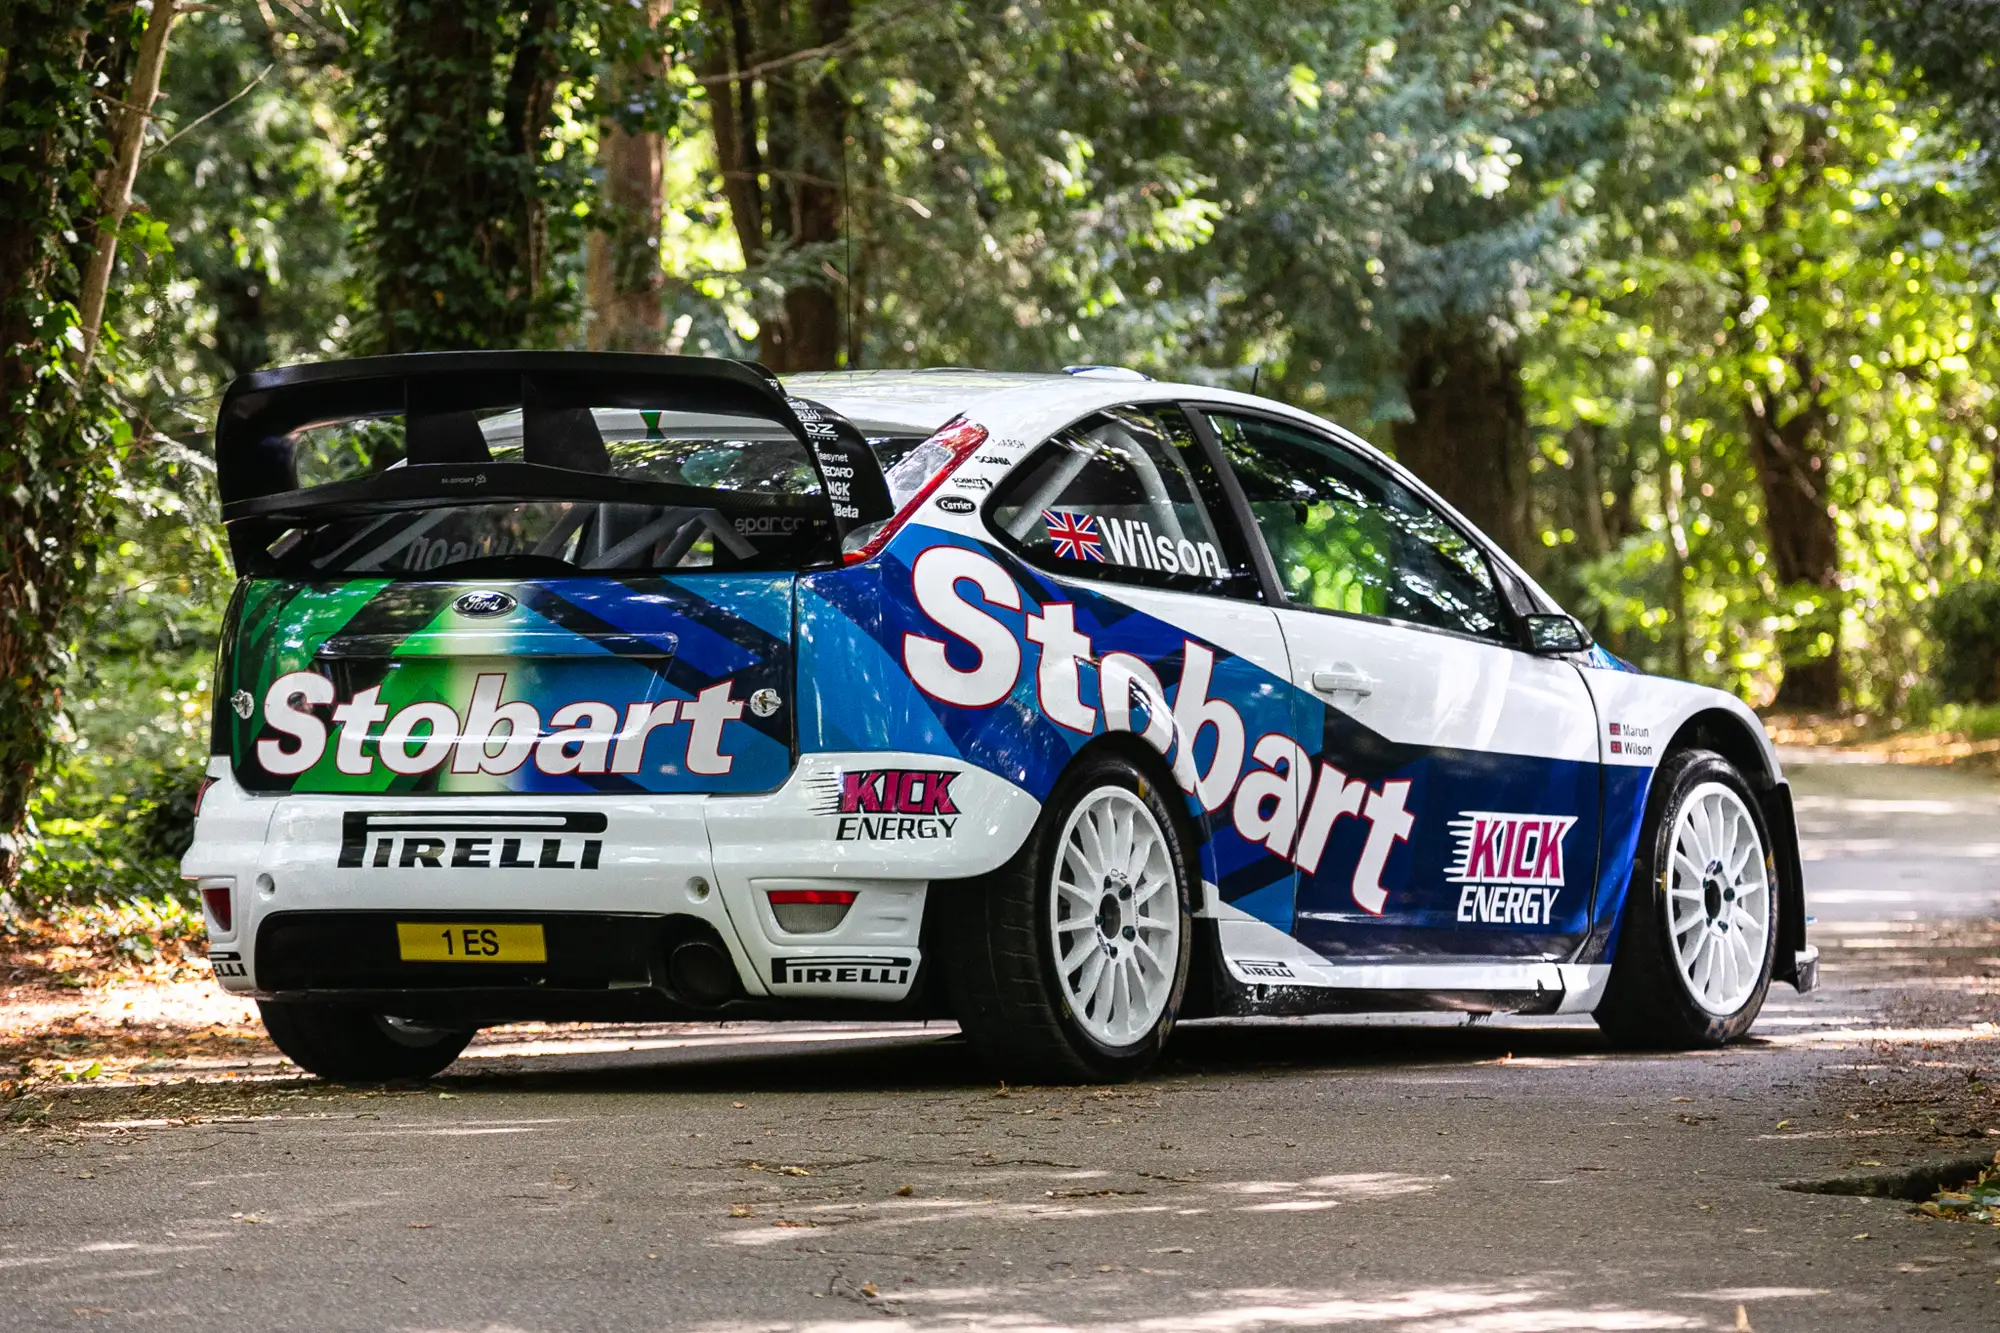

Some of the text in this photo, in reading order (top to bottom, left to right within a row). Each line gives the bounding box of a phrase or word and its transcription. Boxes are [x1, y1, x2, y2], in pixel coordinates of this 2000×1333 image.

[803, 422, 835, 434] OZ
[819, 452, 849, 463] easynet
[975, 455, 1012, 466] SCANIA
[827, 481, 850, 496] NGK
[940, 500, 972, 511] Carrier
[1096, 515, 1224, 578] Wilson
[463, 594, 501, 611] Ford
[256, 670, 743, 777] Stobart
[902, 545, 1417, 917] Stobart
[1624, 741, 1653, 756] Wilson
[838, 768, 964, 816] KICK
[337, 811, 608, 870] PIRELLI
[835, 817, 958, 841] ENERGY
[1462, 811, 1579, 887] KICK
[1110, 868, 1129, 885] OZ
[1457, 885, 1561, 925] ENERGY
[441, 929, 500, 957] 1 ES
[771, 957, 913, 984] PIRELLI
[1233, 959, 1296, 979] PIRELLI
